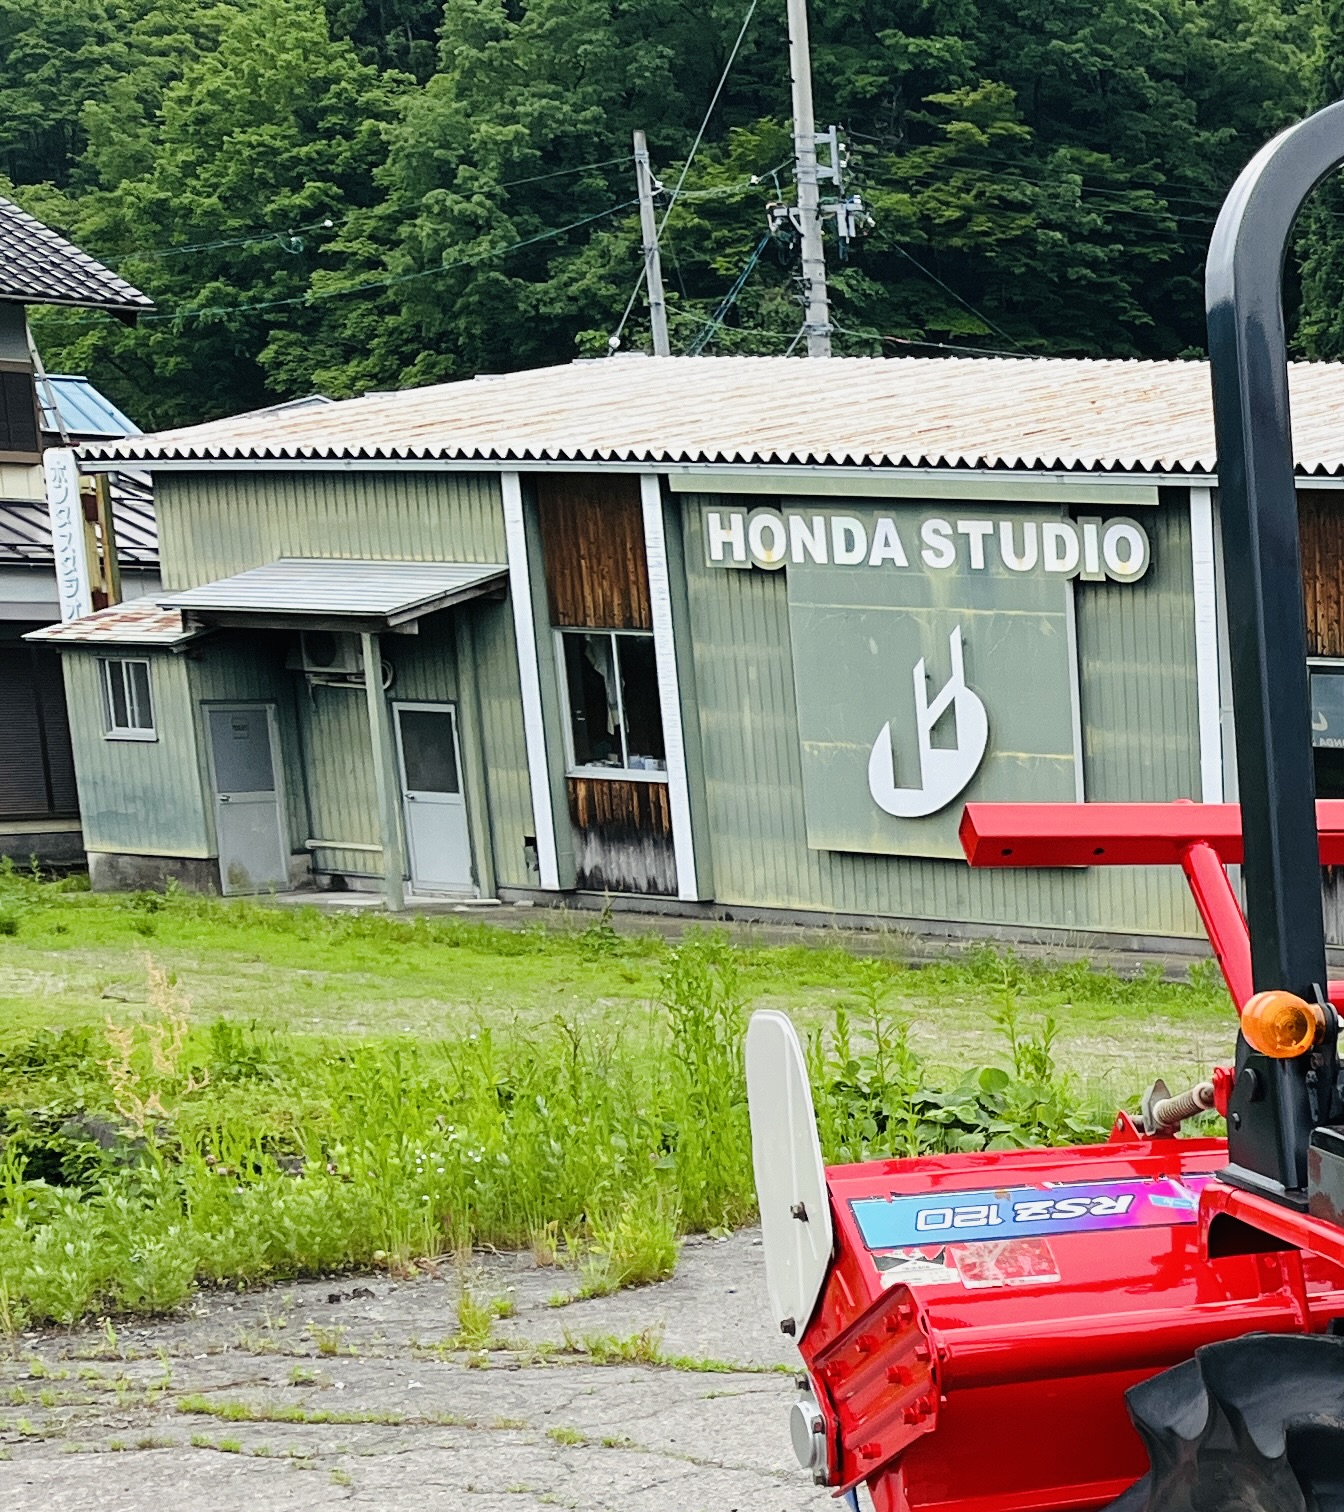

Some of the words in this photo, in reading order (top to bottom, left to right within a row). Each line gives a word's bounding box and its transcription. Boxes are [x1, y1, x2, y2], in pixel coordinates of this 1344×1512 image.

[706, 511, 910, 570] HONDA
[920, 516, 1146, 576] STUDIO
[915, 1203, 1004, 1232] 120
[1014, 1194, 1136, 1223] RSZ
